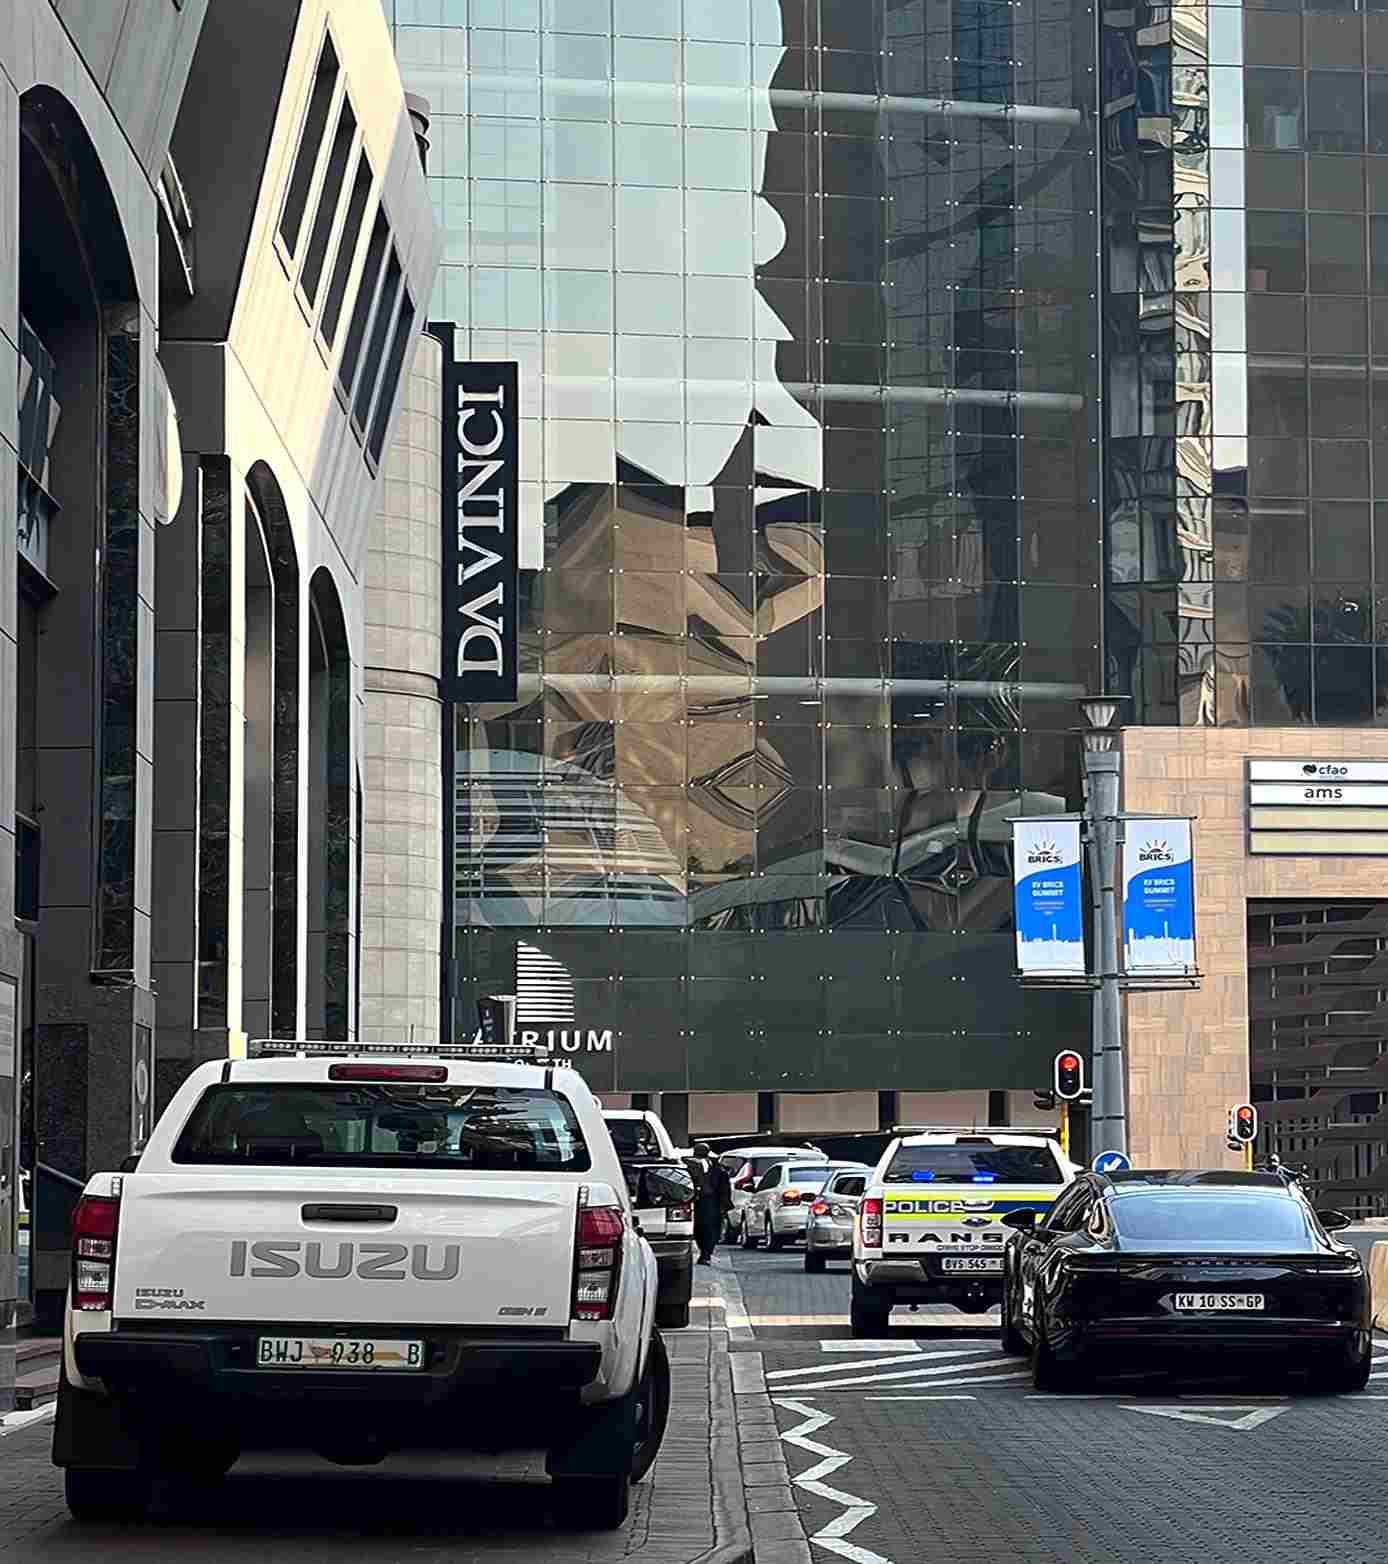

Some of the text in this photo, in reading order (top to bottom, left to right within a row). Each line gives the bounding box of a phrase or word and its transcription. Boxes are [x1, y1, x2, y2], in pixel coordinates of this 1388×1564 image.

[457, 384, 505, 677] DAVINCI
[1318, 764, 1349, 775] cfao
[1303, 788, 1343, 799] ams
[473, 1028, 613, 1052] RIUM
[884, 1200, 966, 1214] POLICE
[887, 1232, 1004, 1244] RANG
[229, 1240, 461, 1282] ISUZU
[135, 1287, 185, 1298] ISUZU
[1178, 1295, 1263, 1308] KW 10 SS GP
[407, 1343, 419, 1365] B
